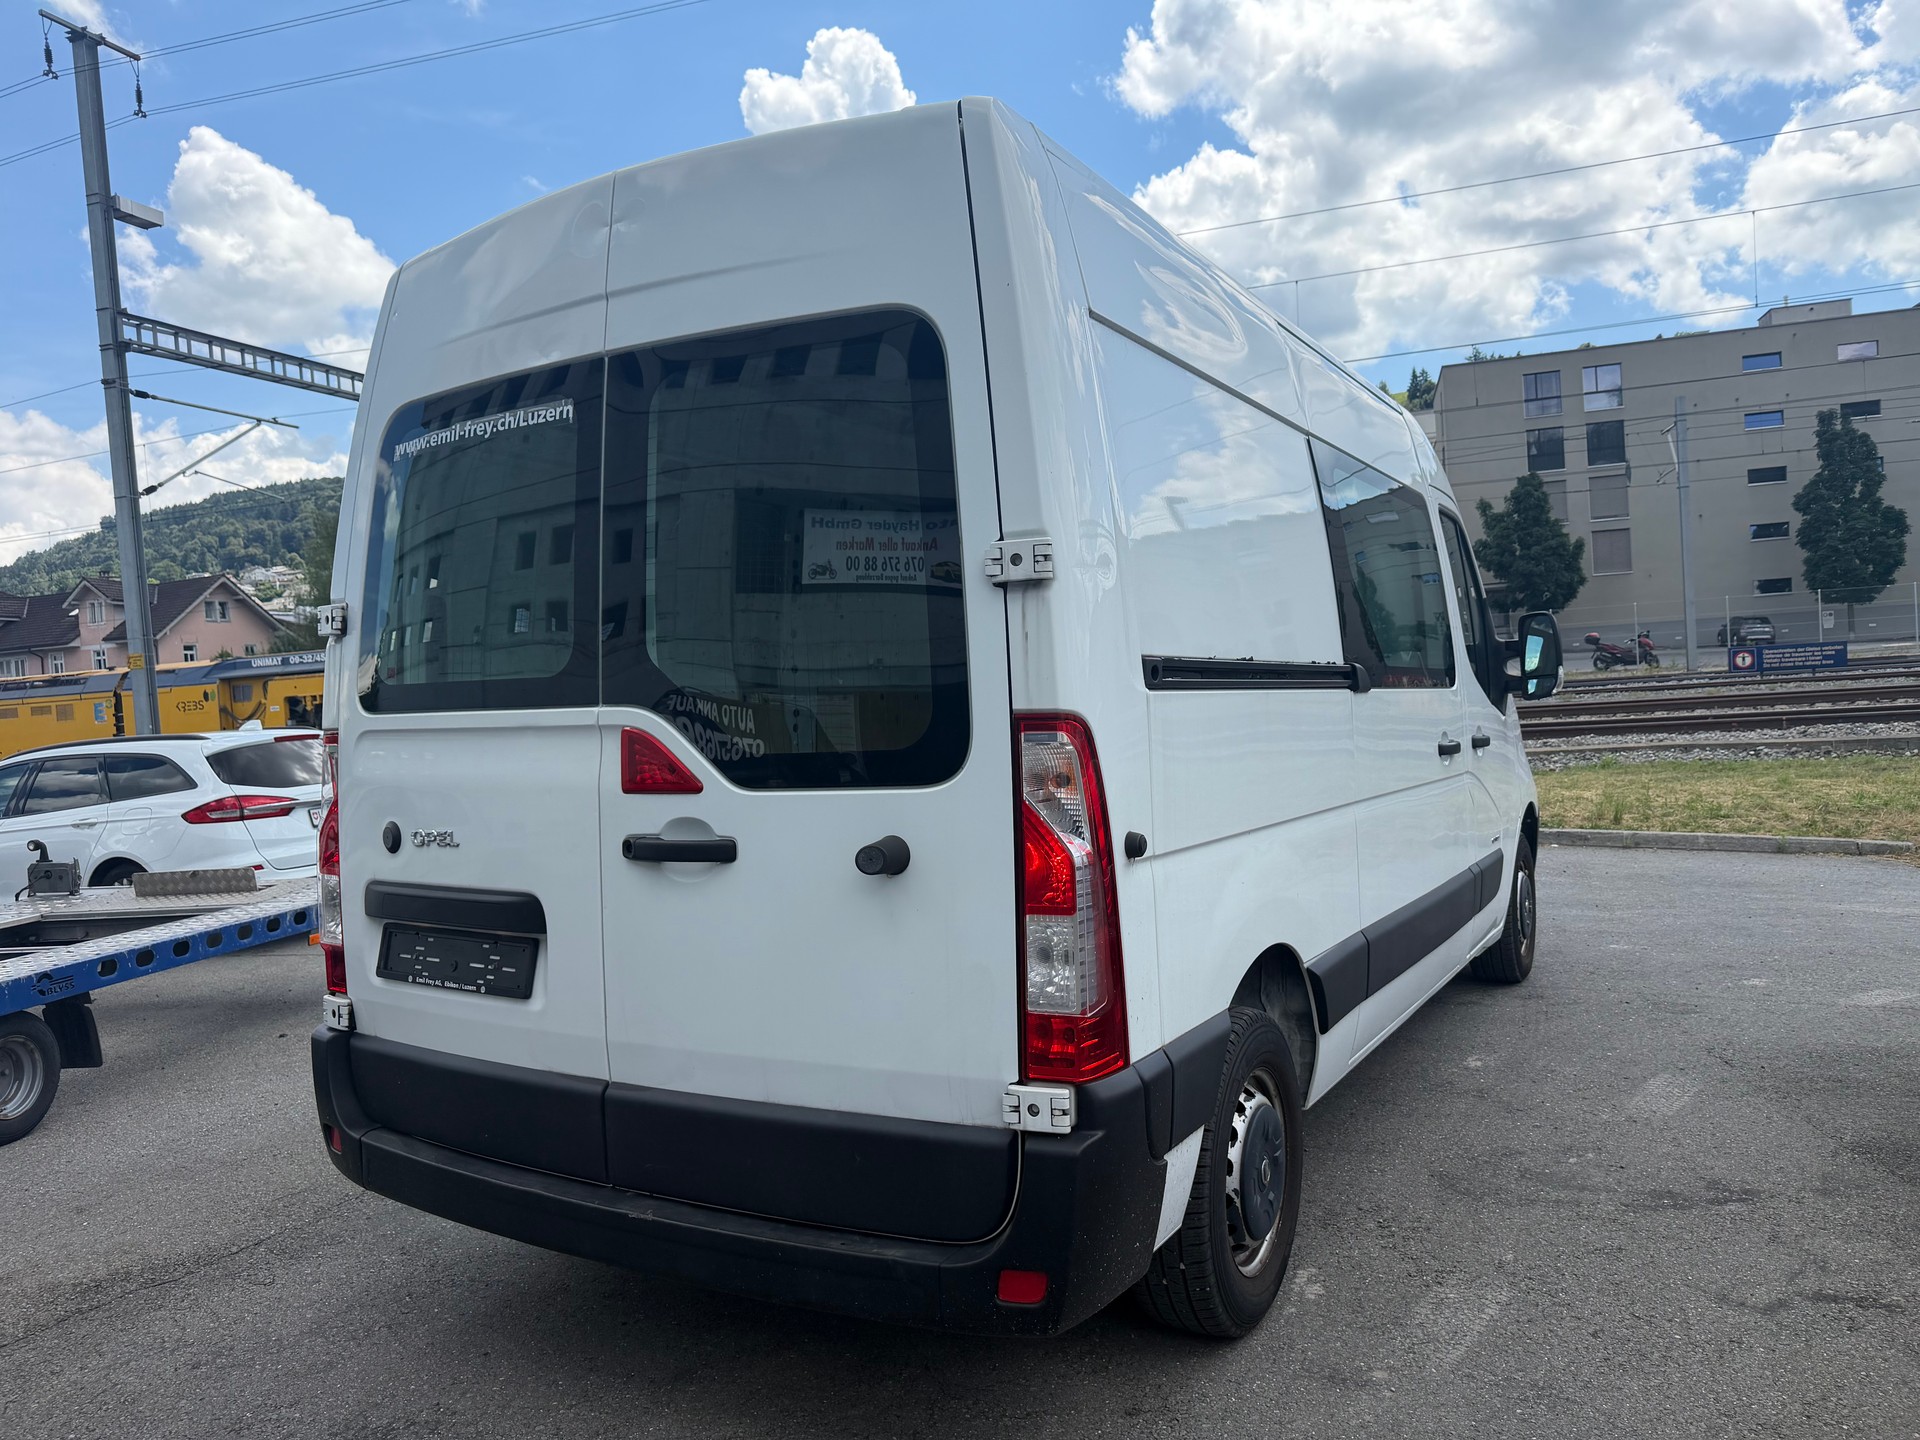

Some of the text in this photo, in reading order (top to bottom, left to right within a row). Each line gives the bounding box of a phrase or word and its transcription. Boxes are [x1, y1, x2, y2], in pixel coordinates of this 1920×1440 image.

[395, 402, 573, 457] www.emil-frey.ch/Luzern
[251, 656, 282, 667] UNIMAT
[176, 700, 205, 712] KREBS
[411, 829, 460, 848] OPEL
[46, 981, 75, 996] BLYSS
